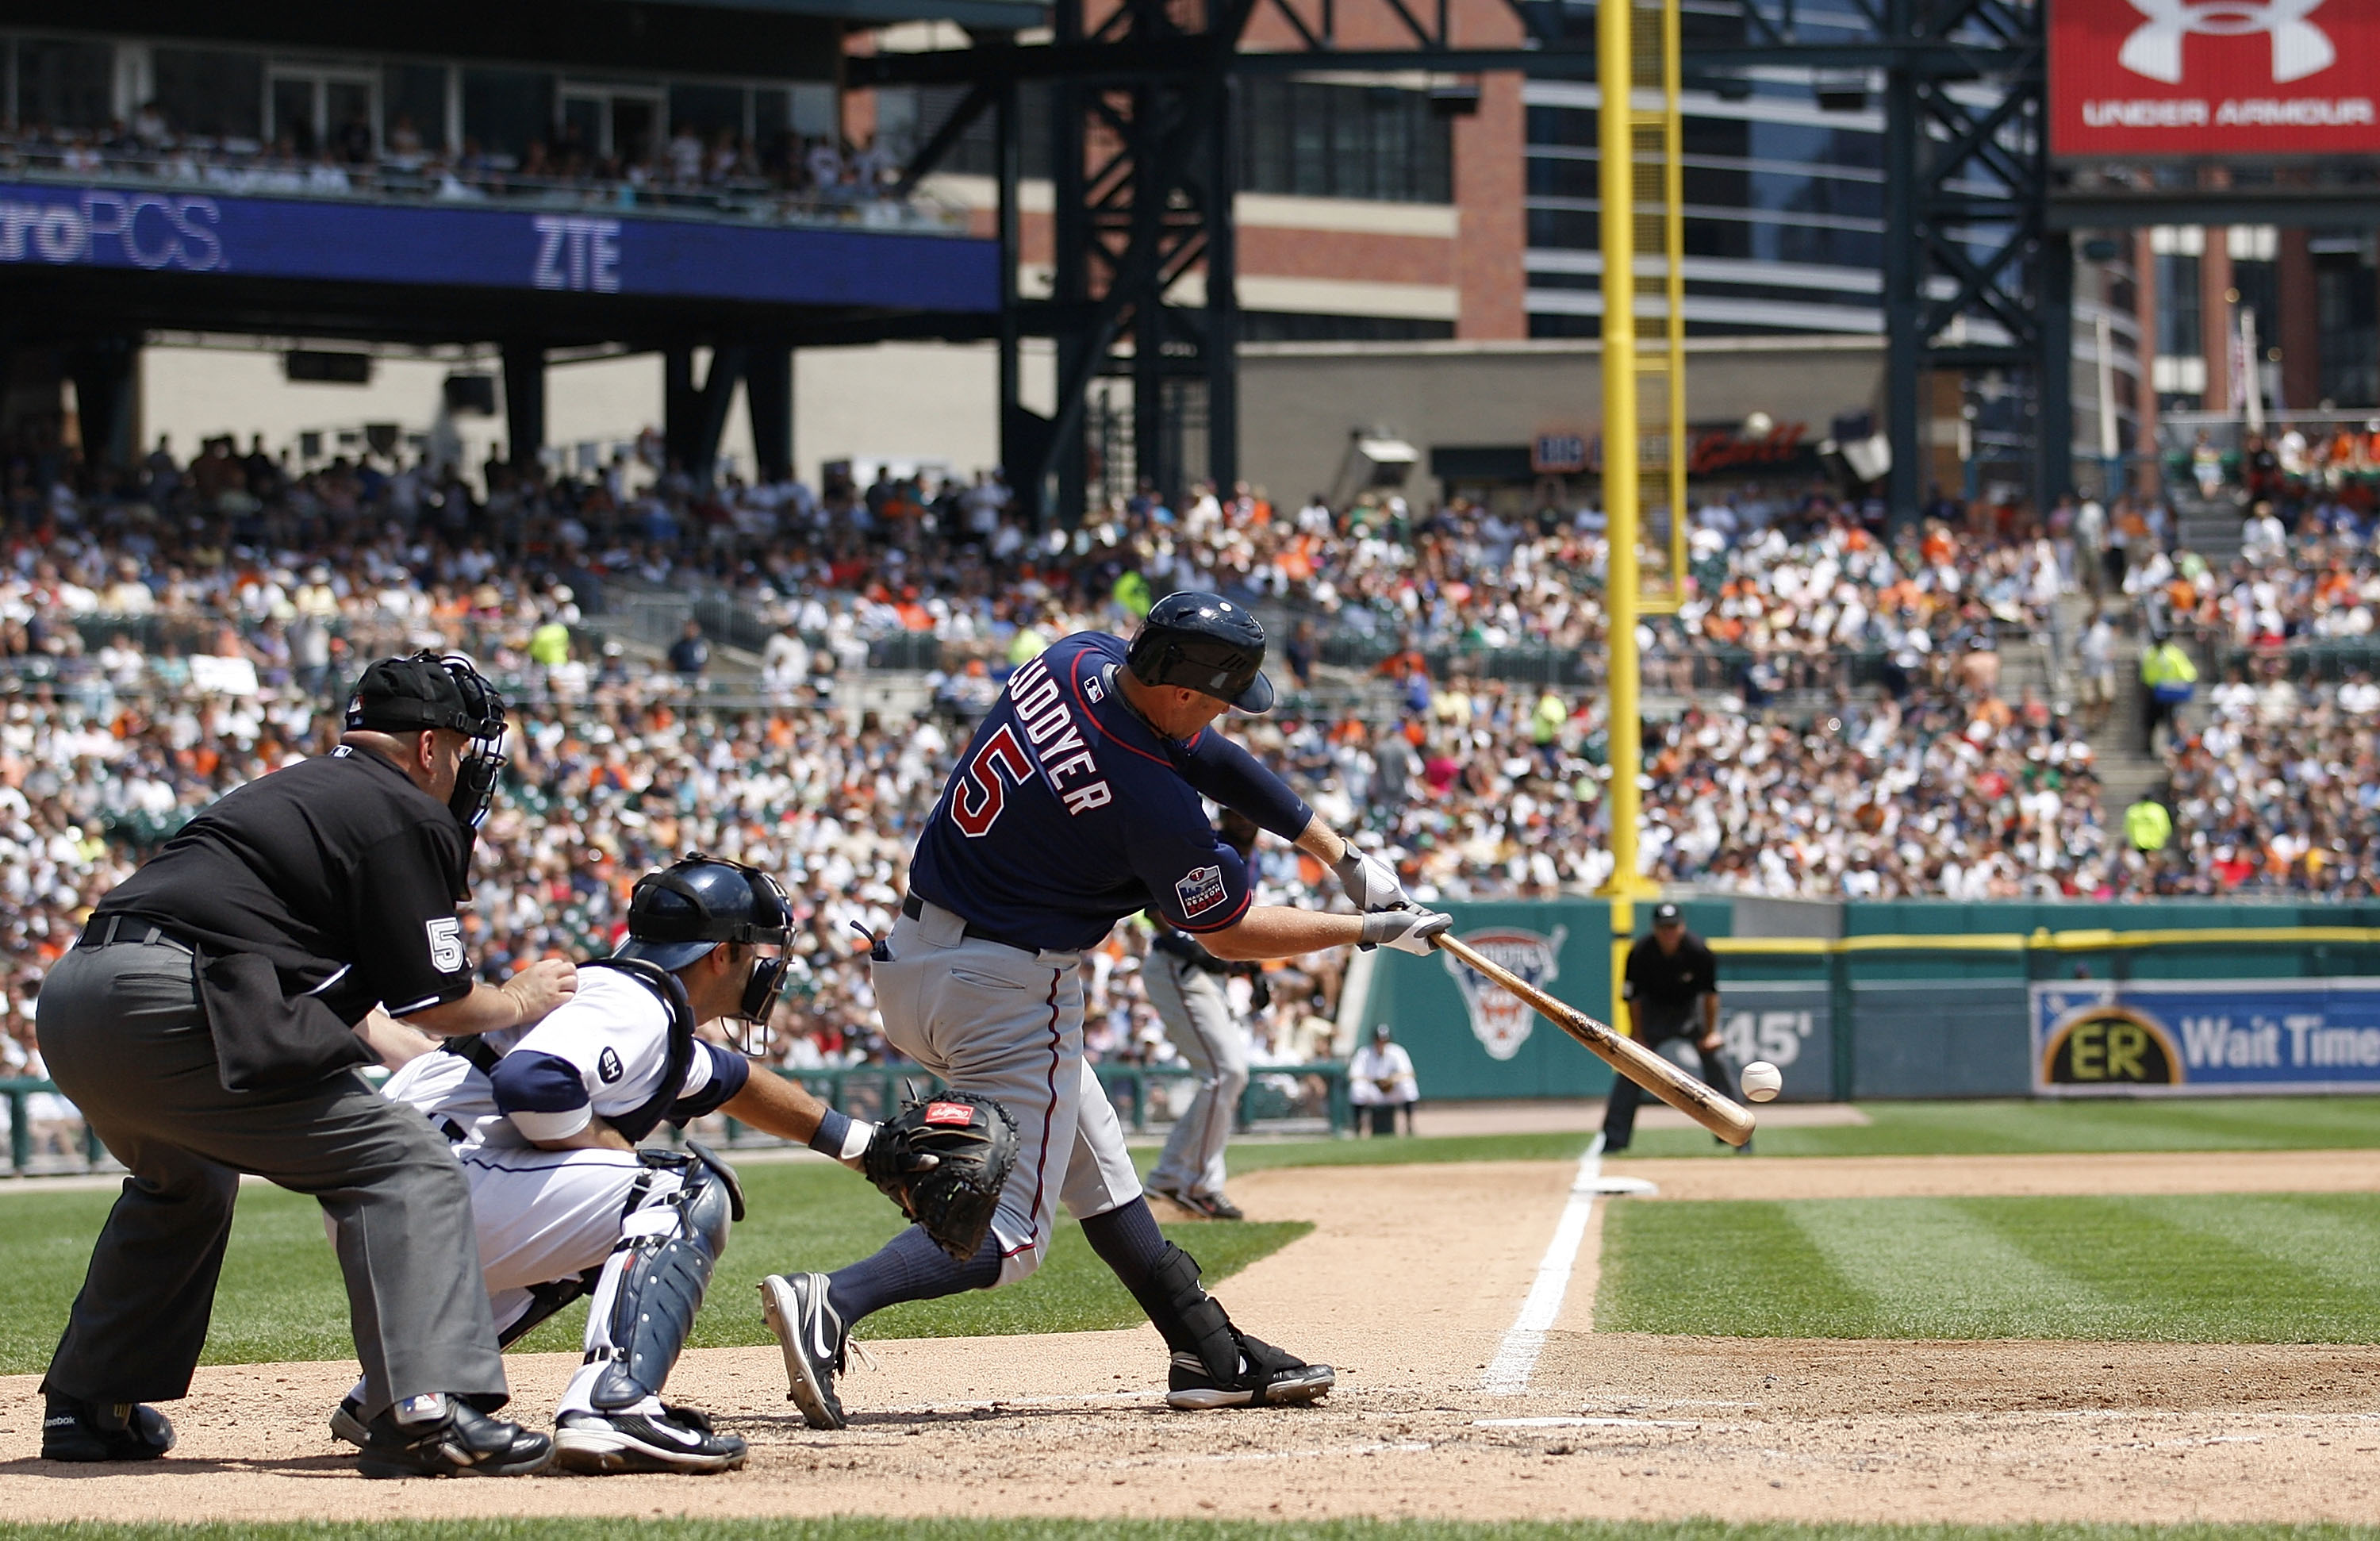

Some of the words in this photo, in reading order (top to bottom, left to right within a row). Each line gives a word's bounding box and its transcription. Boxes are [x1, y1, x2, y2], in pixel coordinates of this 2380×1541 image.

[2082, 98, 2210, 127] UNDER
[2215, 97, 2375, 127] ARMOUR
[534, 217, 620, 294] ZTE
[951, 722, 1036, 838] 5
[1186, 886, 1221, 907] SEASON
[603, 1049, 620, 1080] EH
[2069, 1023, 2150, 1081] ER
[2179, 1016, 2281, 1068] Wait
[2284, 1015, 2380, 1068] Time
